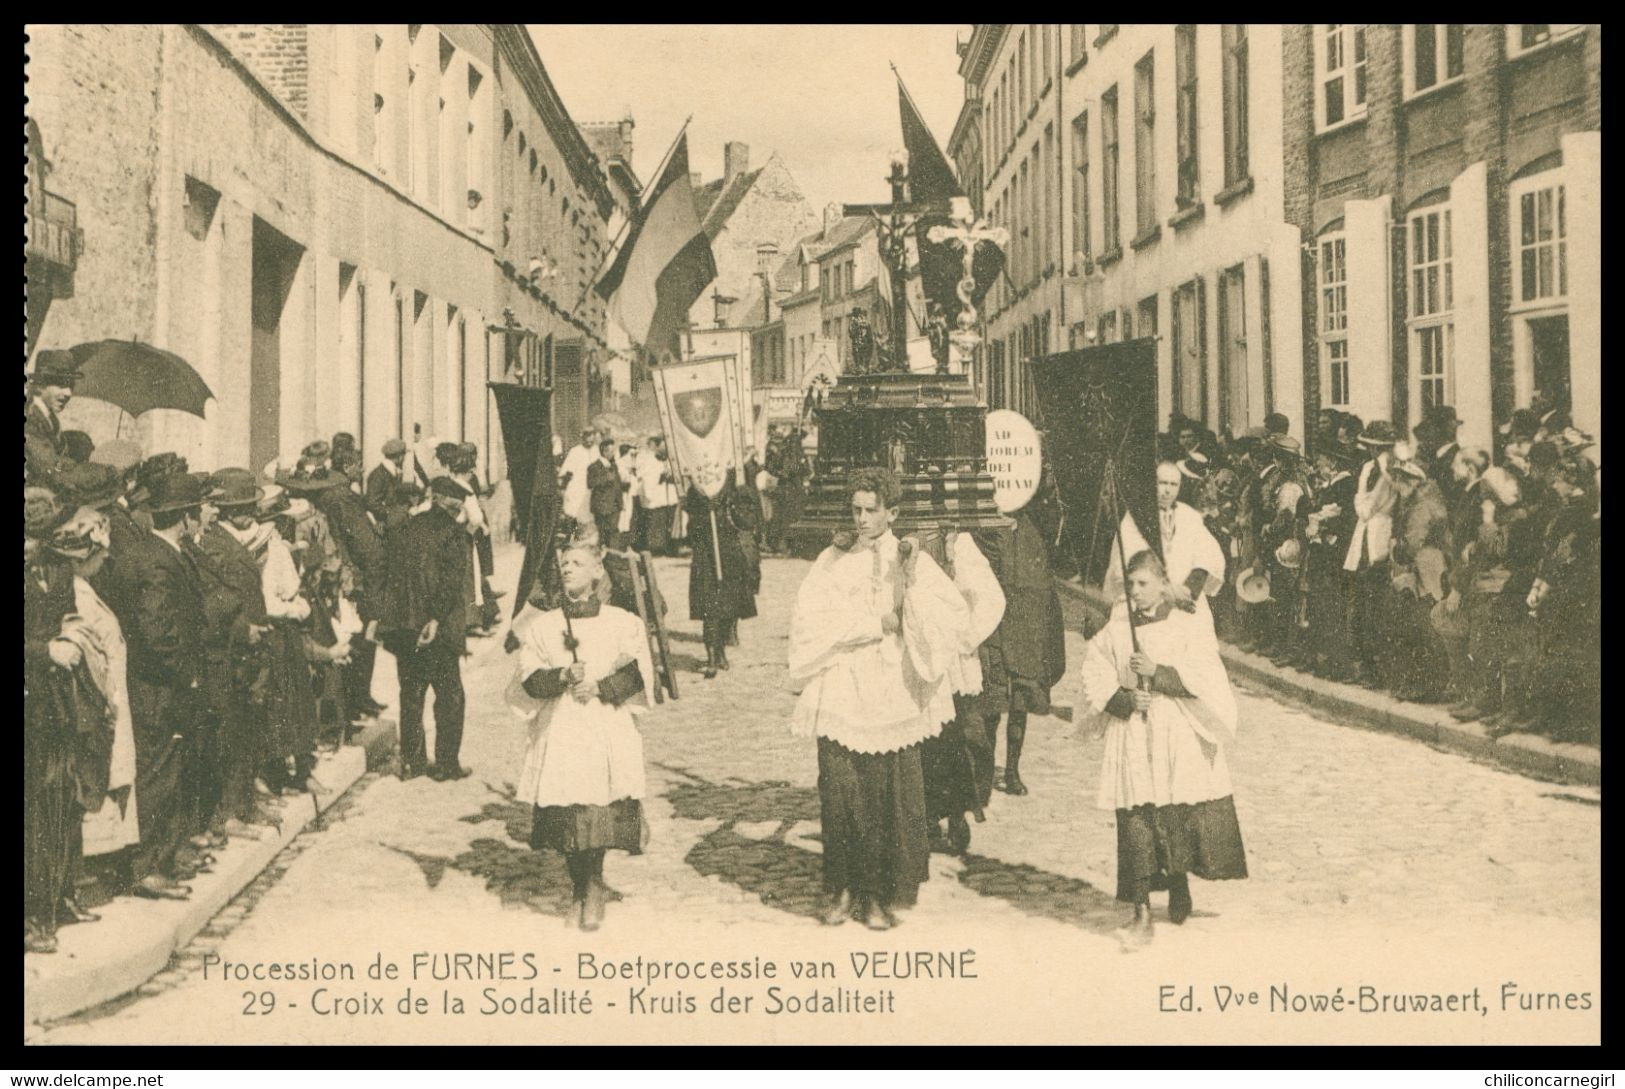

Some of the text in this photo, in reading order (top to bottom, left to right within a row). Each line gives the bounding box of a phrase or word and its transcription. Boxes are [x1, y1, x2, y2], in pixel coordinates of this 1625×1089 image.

[994, 430, 1011, 440] AD
[989, 462, 1011, 473] DEI
[997, 479, 1033, 489] RIAM
